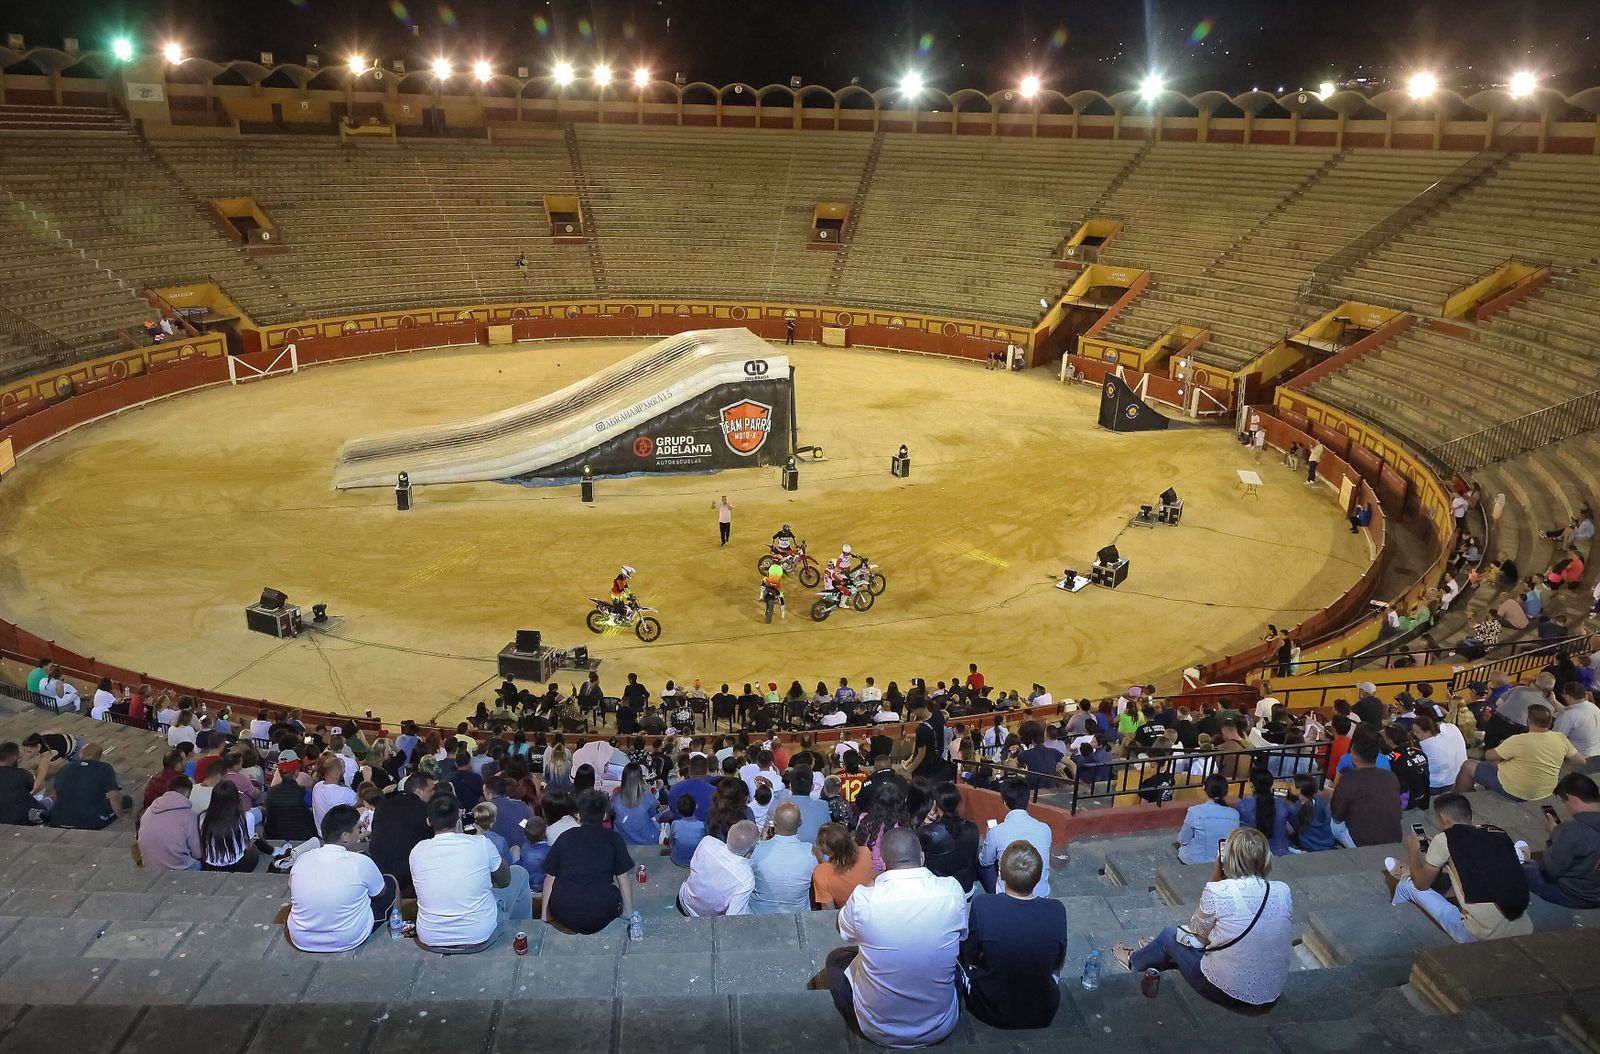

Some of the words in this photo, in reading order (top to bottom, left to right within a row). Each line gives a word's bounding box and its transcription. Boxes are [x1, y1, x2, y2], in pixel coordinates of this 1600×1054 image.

[595, 389, 673, 432] @ABRAHAMPARRA15
[719, 418, 743, 435] TEAM
[744, 417, 772, 433] PARRA
[655, 435, 695, 447] GRUPO
[734, 431, 757, 440] MOTO-X
[655, 443, 713, 456] ADELANTA
[655, 458, 702, 467] AUTOESCUELAS
[841, 779, 862, 802] 12
